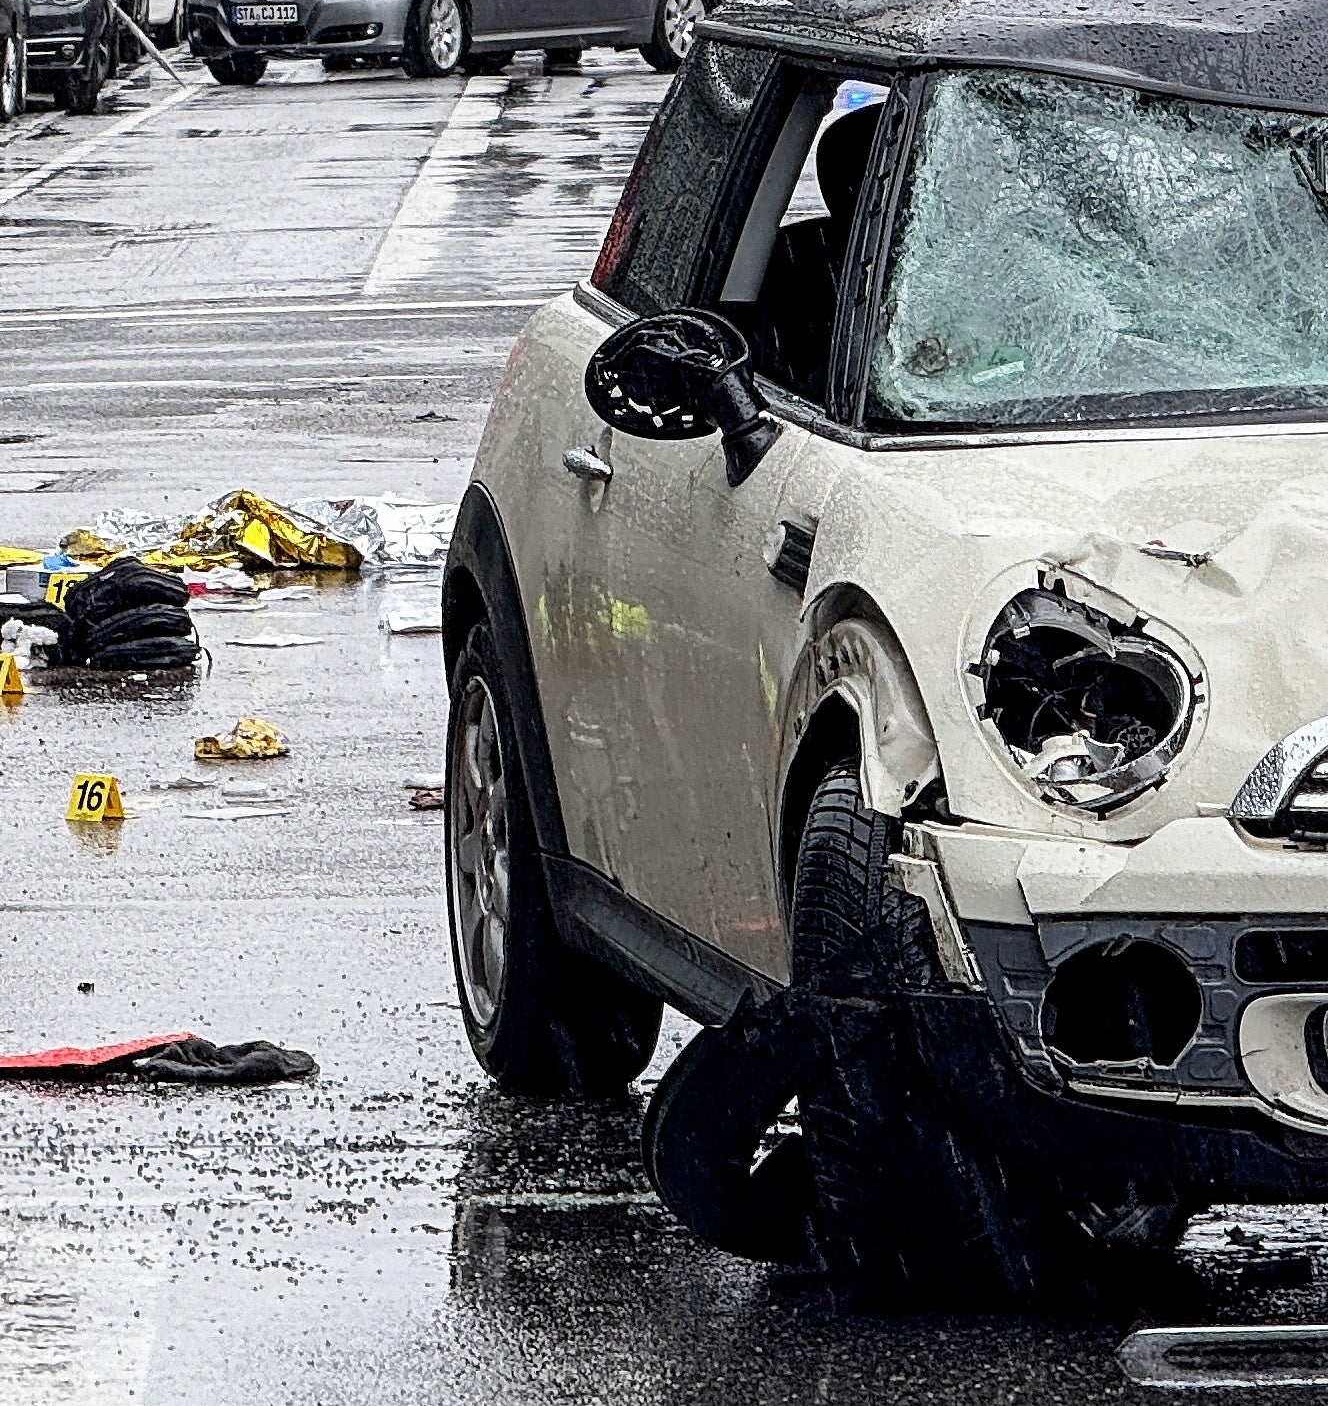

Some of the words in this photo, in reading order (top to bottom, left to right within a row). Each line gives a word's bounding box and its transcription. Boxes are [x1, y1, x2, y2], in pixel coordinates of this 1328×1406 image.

[238, 7, 256, 20] STA
[277, 6, 296, 20] 112
[77, 780, 106, 812] 16
